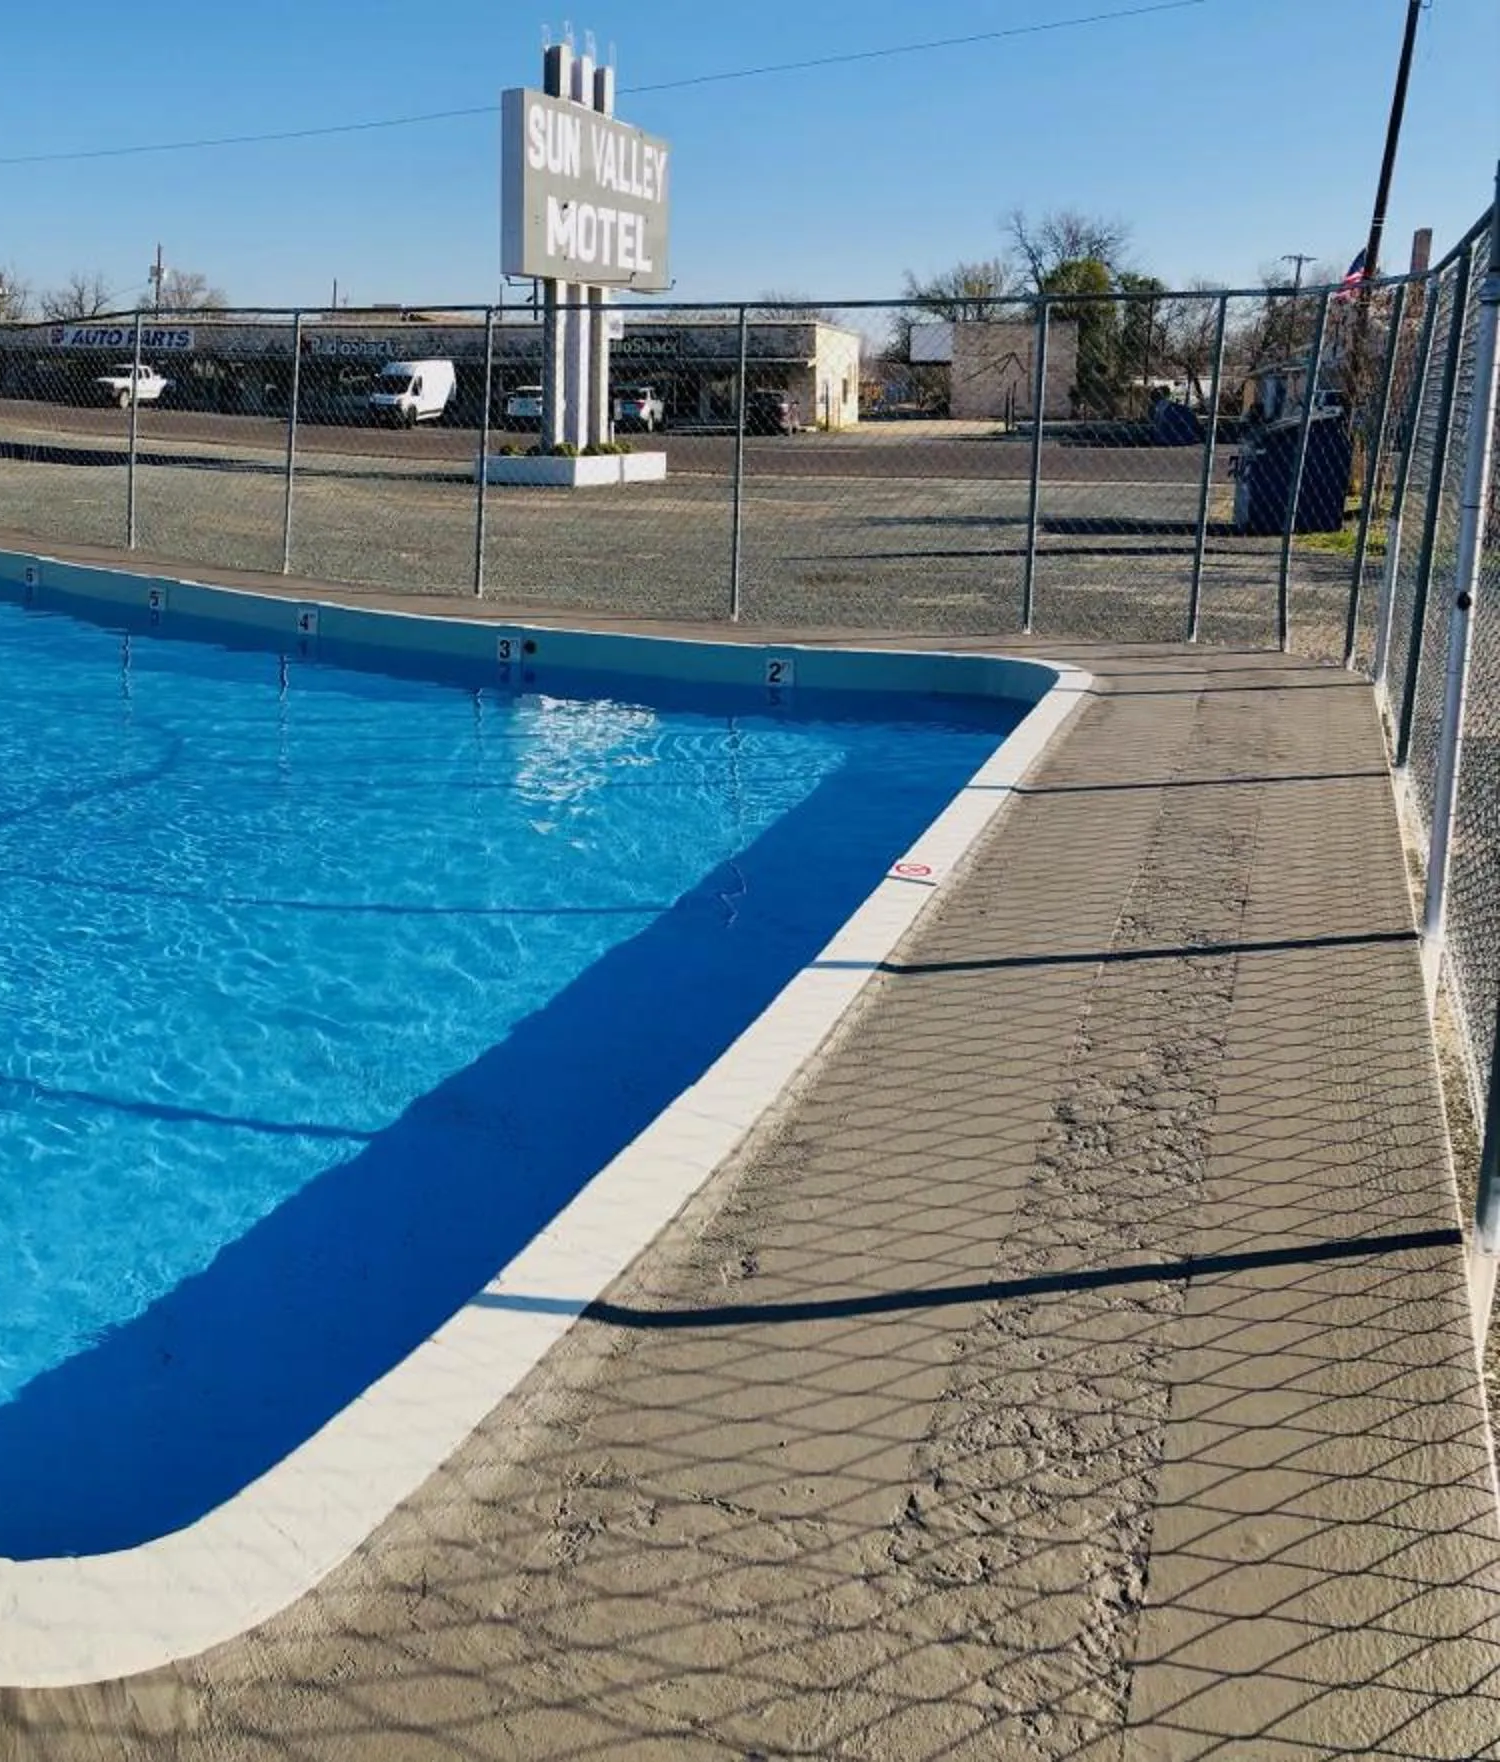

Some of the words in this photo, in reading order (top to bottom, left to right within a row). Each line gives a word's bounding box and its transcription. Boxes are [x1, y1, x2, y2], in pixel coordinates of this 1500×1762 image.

[528, 104, 581, 179] SUN
[592, 123, 669, 204] VALLEY
[547, 195, 653, 273] MOTEL
[71, 329, 124, 345] AUTO
[127, 329, 190, 347] PARTS
[299, 612, 309, 631] 4
[499, 639, 511, 659] 3
[769, 661, 782, 683] 2
